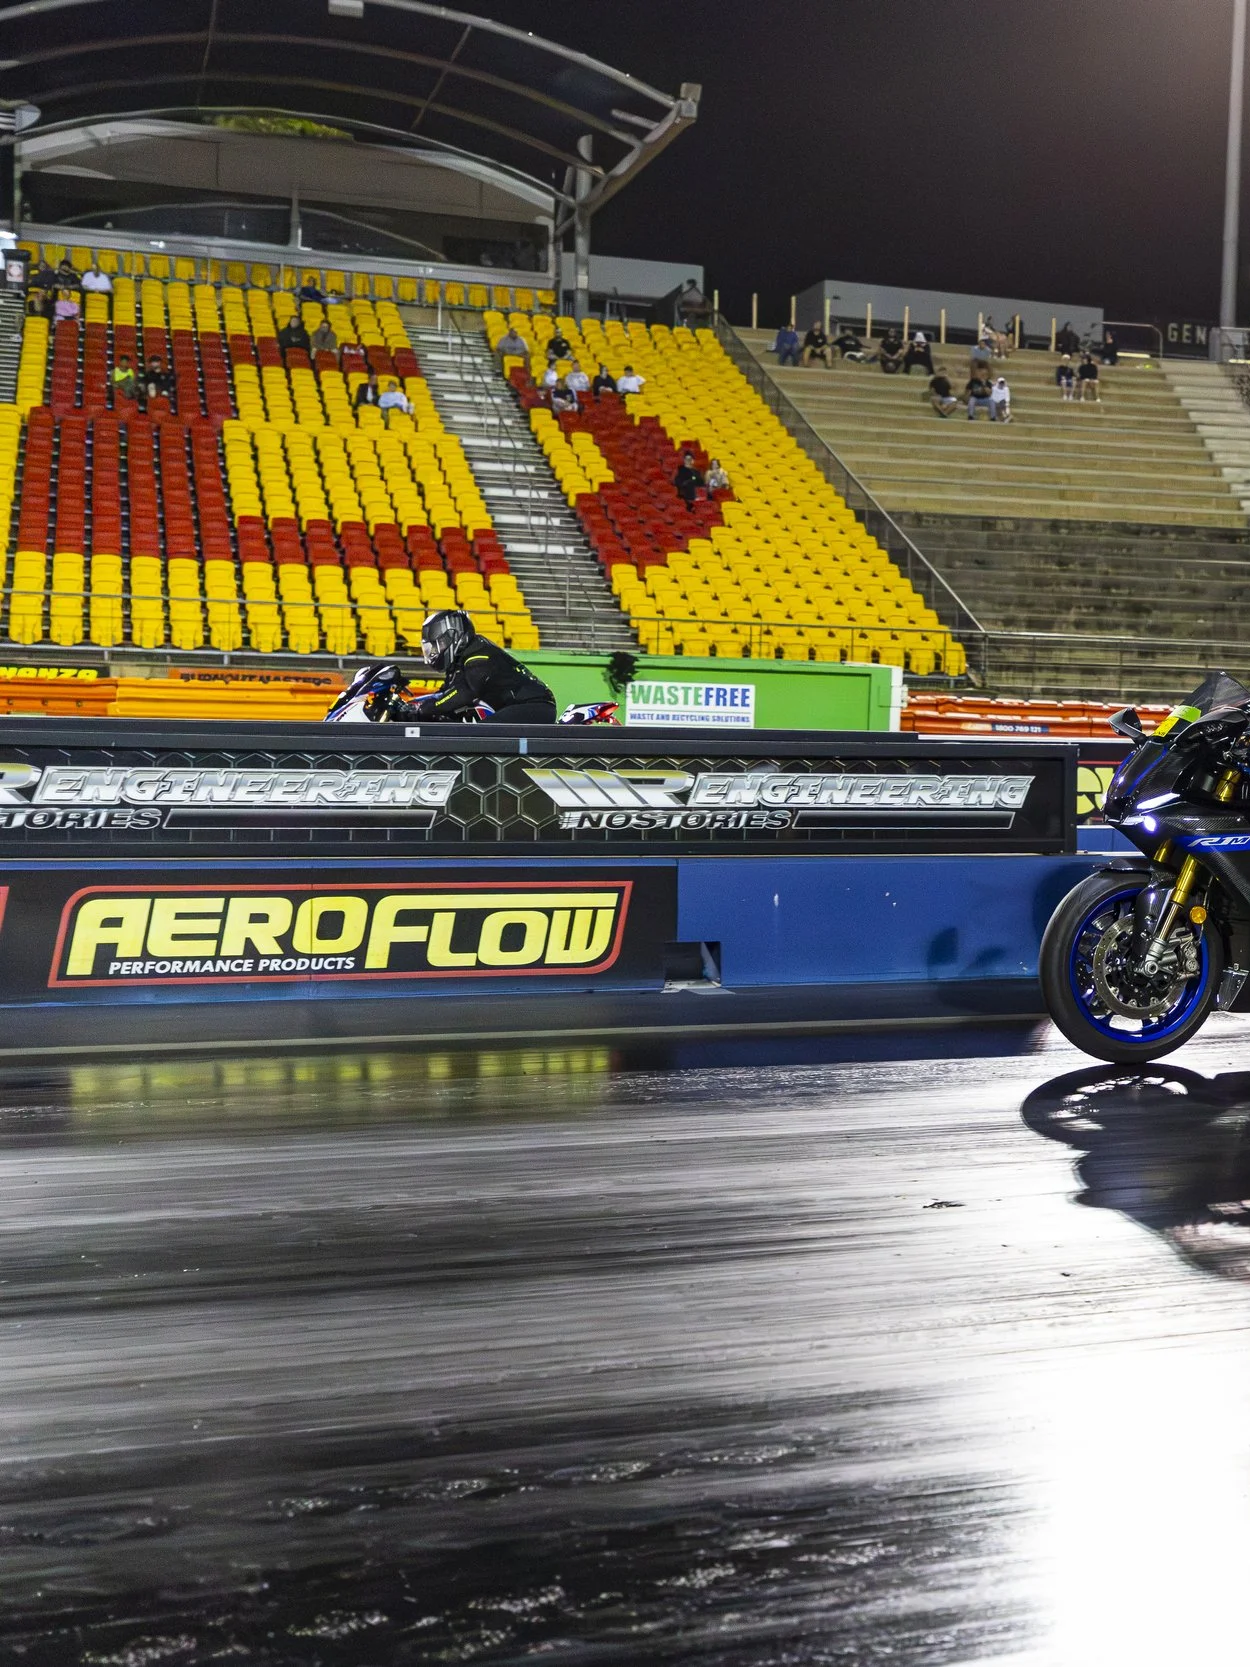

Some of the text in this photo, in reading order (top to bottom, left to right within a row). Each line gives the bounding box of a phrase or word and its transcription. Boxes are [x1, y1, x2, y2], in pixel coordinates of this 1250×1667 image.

[631, 684, 750, 707] WASTEFREE
[672, 714, 710, 722] RECYCLING
[712, 715, 750, 723] SOLUTIONS
[33, 766, 462, 807] ENGINEERING
[687, 772, 1036, 808] ENGINEERING
[65, 893, 619, 977] AEROFLOW
[108, 957, 355, 976] PERFORMANCE PRODUCTS
